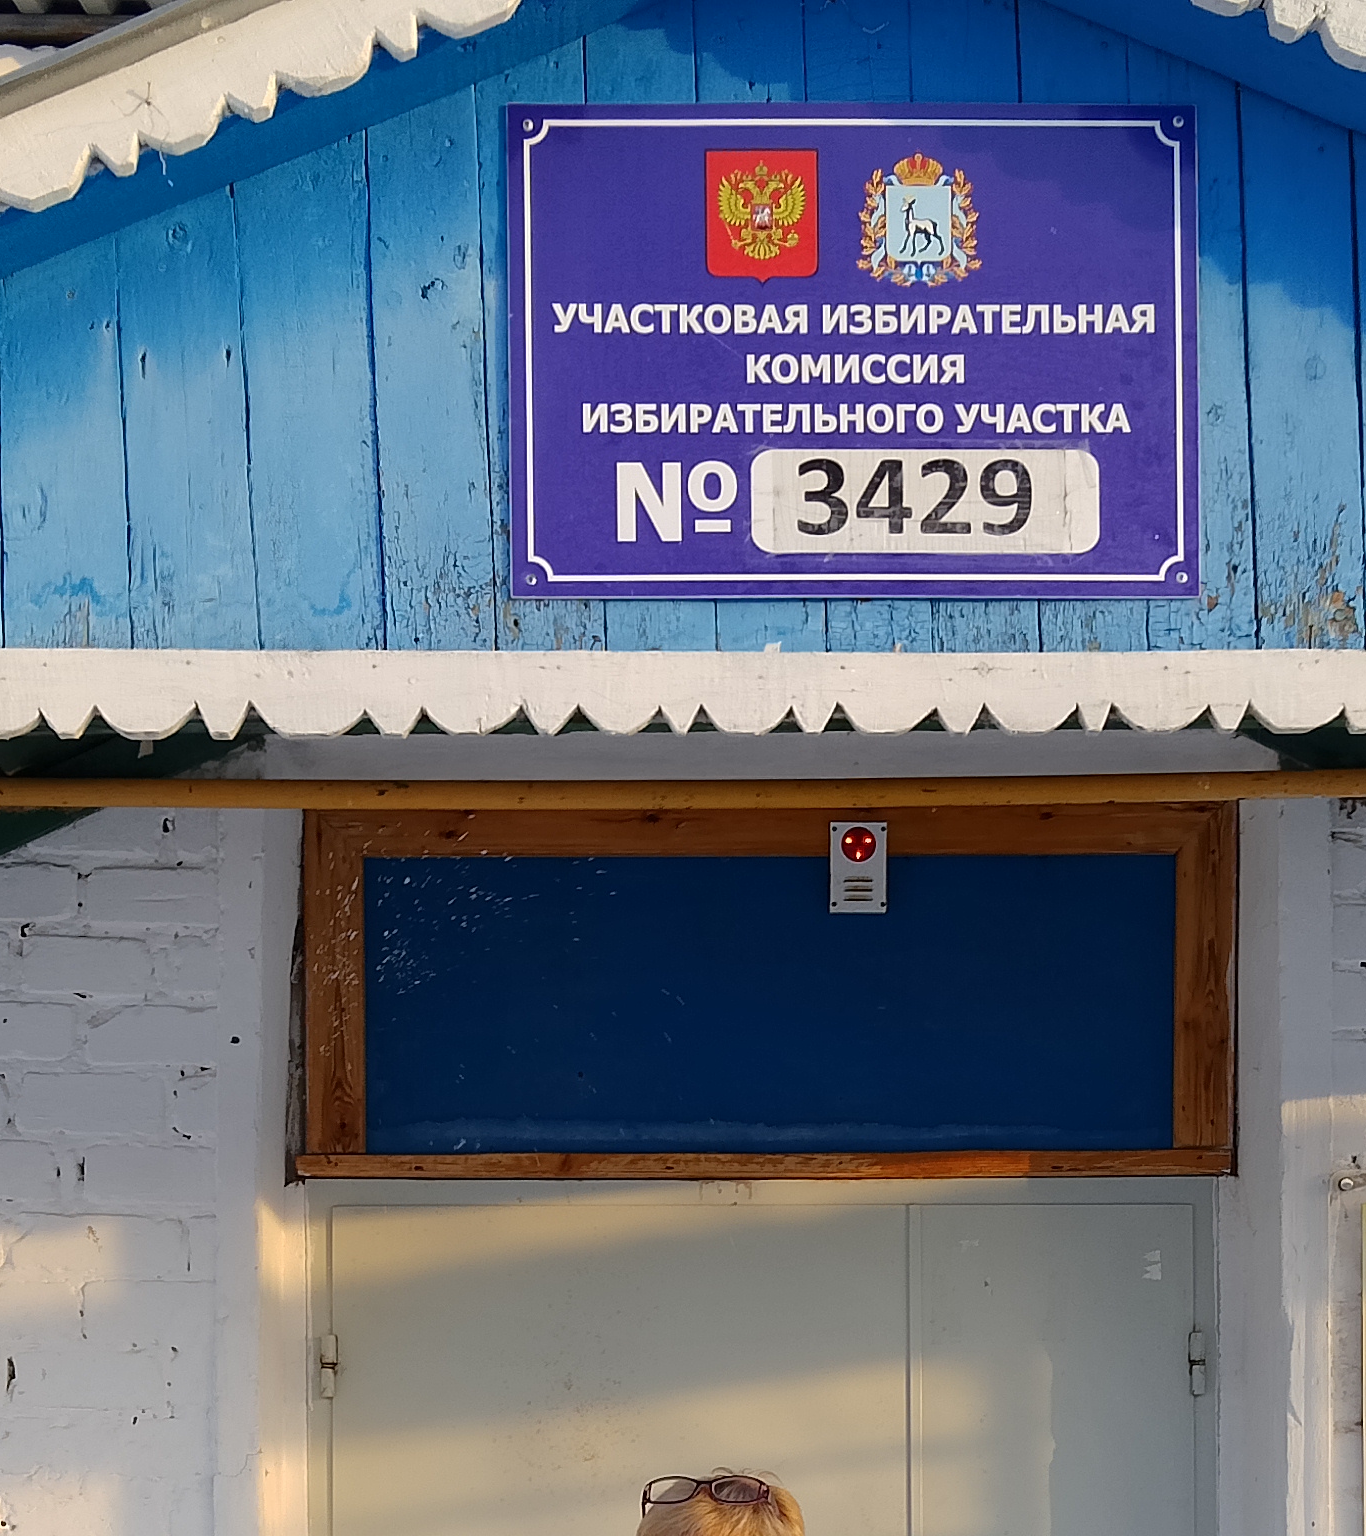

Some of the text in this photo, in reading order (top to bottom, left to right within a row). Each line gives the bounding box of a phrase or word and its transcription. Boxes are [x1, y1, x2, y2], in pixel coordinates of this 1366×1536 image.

[551, 303, 1156, 335] УЧАСТКОВАЯ ИЗБИРАТЕЛЬНАЯ
[745, 353, 966, 384] КОМИССИЯ
[581, 403, 1131, 435] ИЗБИРАТЕЛЬНОГО УЧАСТКА
[616, 458, 1034, 543] № 3429
